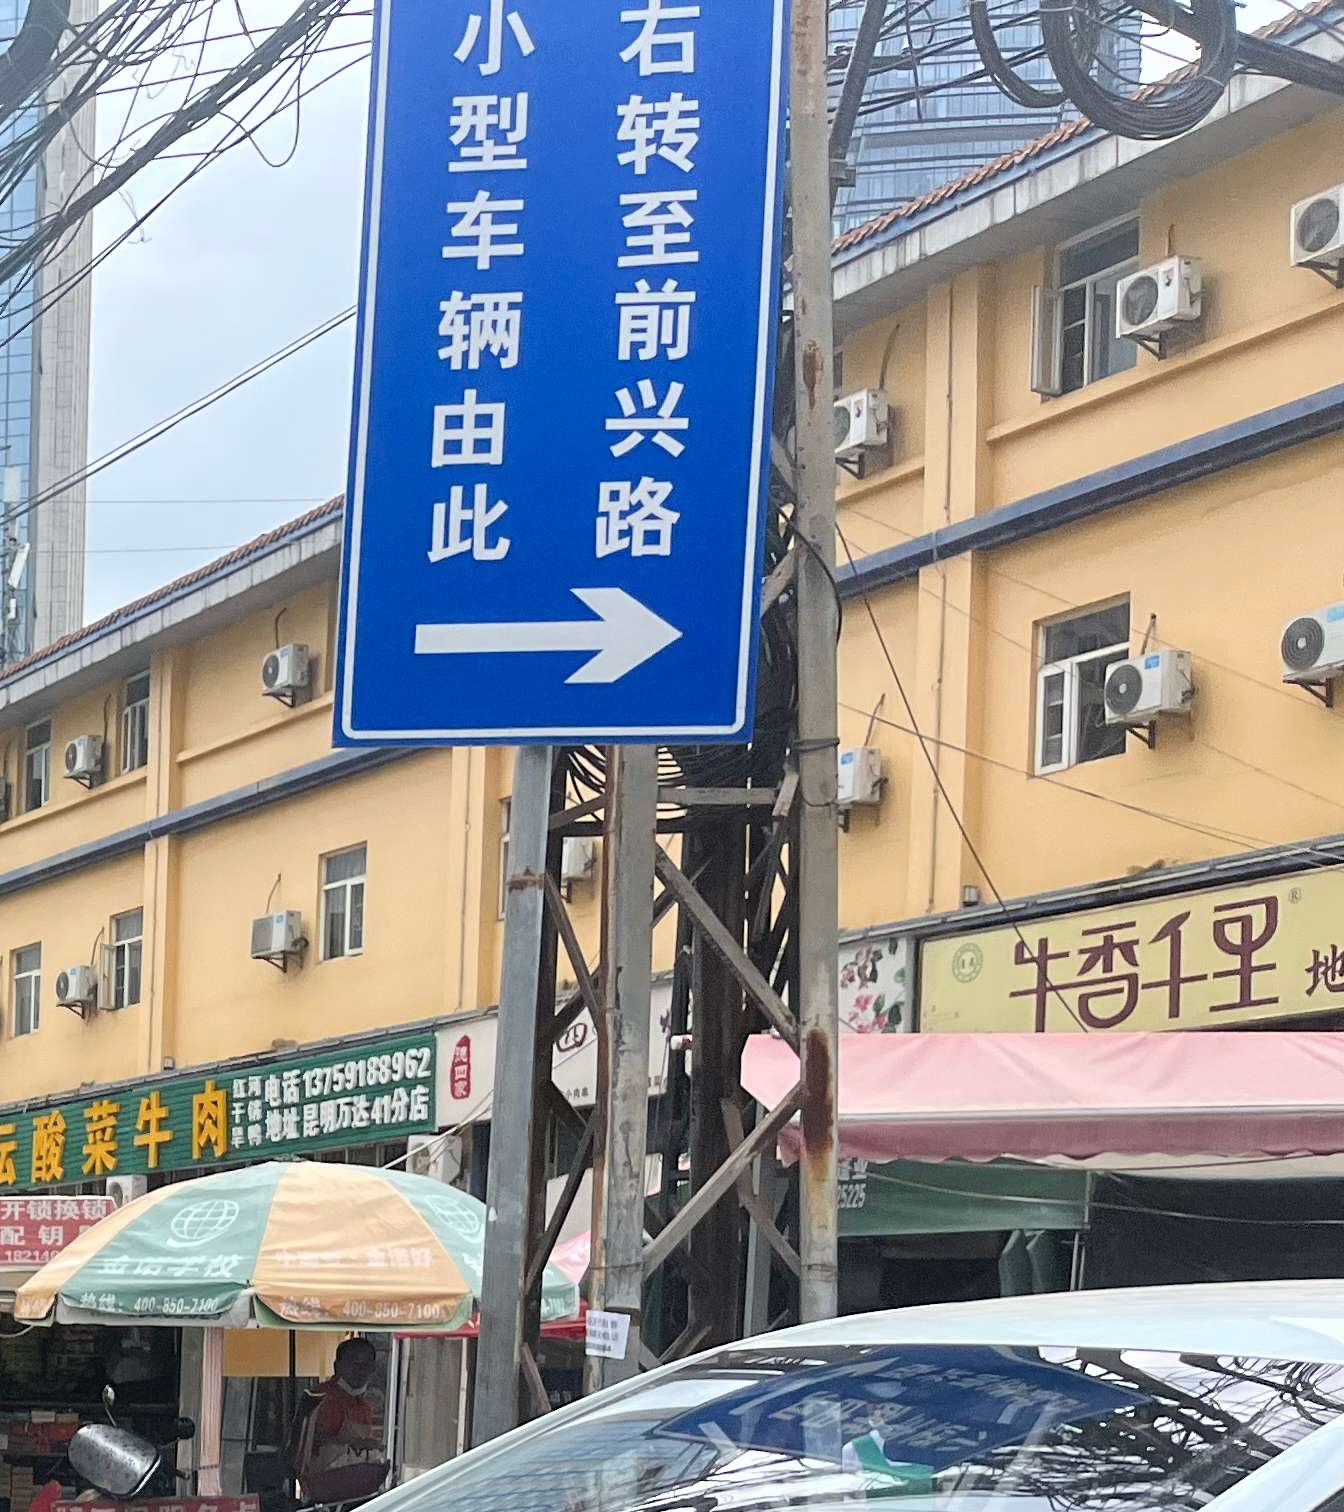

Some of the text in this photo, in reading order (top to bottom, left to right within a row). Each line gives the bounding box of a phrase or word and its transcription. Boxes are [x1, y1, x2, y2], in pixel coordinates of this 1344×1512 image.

[428, 0, 535, 564] 小型车辆由此
[596, 0, 701, 558] 右转至前兴路
[1, 1200, 106, 1220] 开锁换锁
